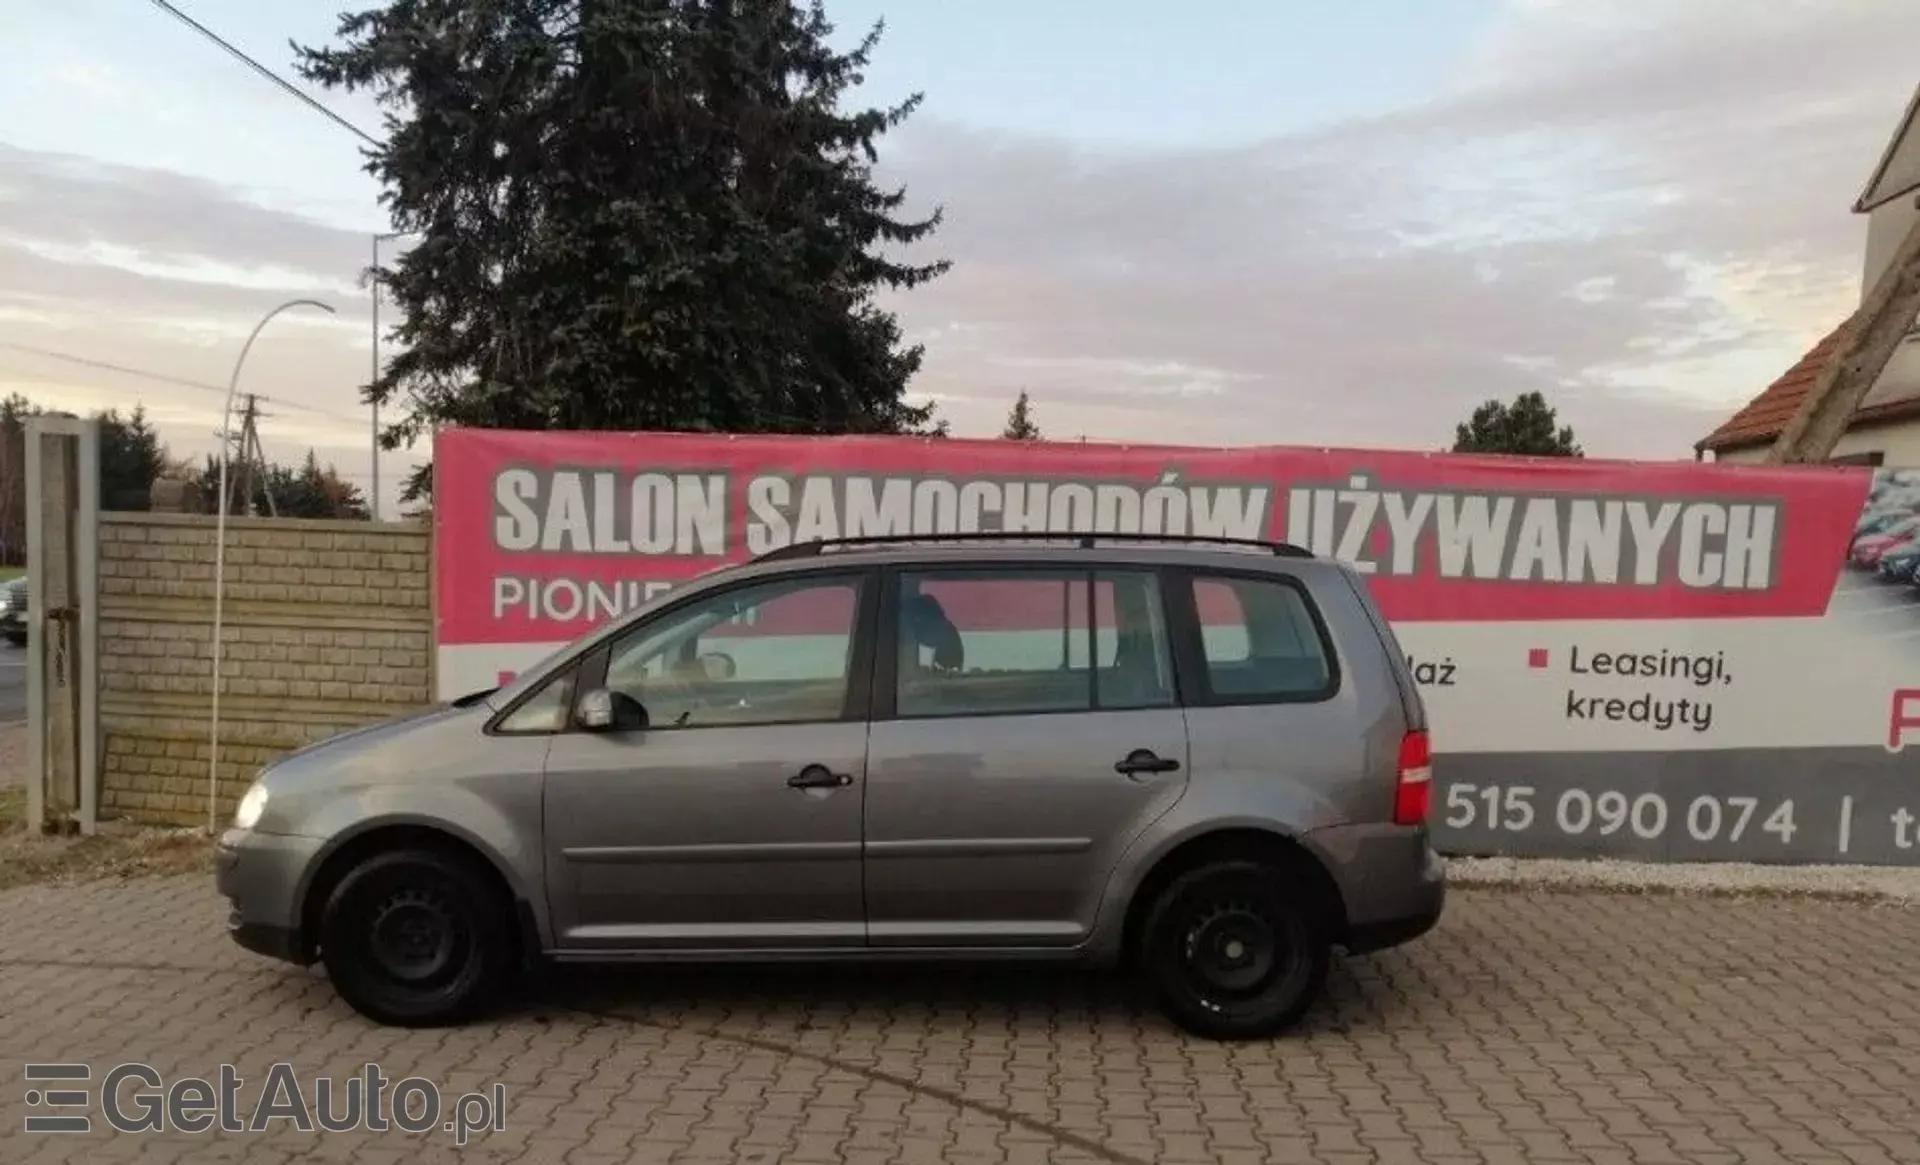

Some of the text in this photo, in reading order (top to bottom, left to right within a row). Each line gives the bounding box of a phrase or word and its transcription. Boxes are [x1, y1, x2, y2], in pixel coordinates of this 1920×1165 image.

[495, 468, 1776, 590] SALON SAMOCHODÓW UŻYWANYCH
[1570, 646, 1732, 685] Leasingi,
[1566, 690, 1713, 731] kredyty
[1445, 783, 1534, 831] 515
[1555, 788, 1668, 840] 090
[1687, 795, 1797, 844] 074
